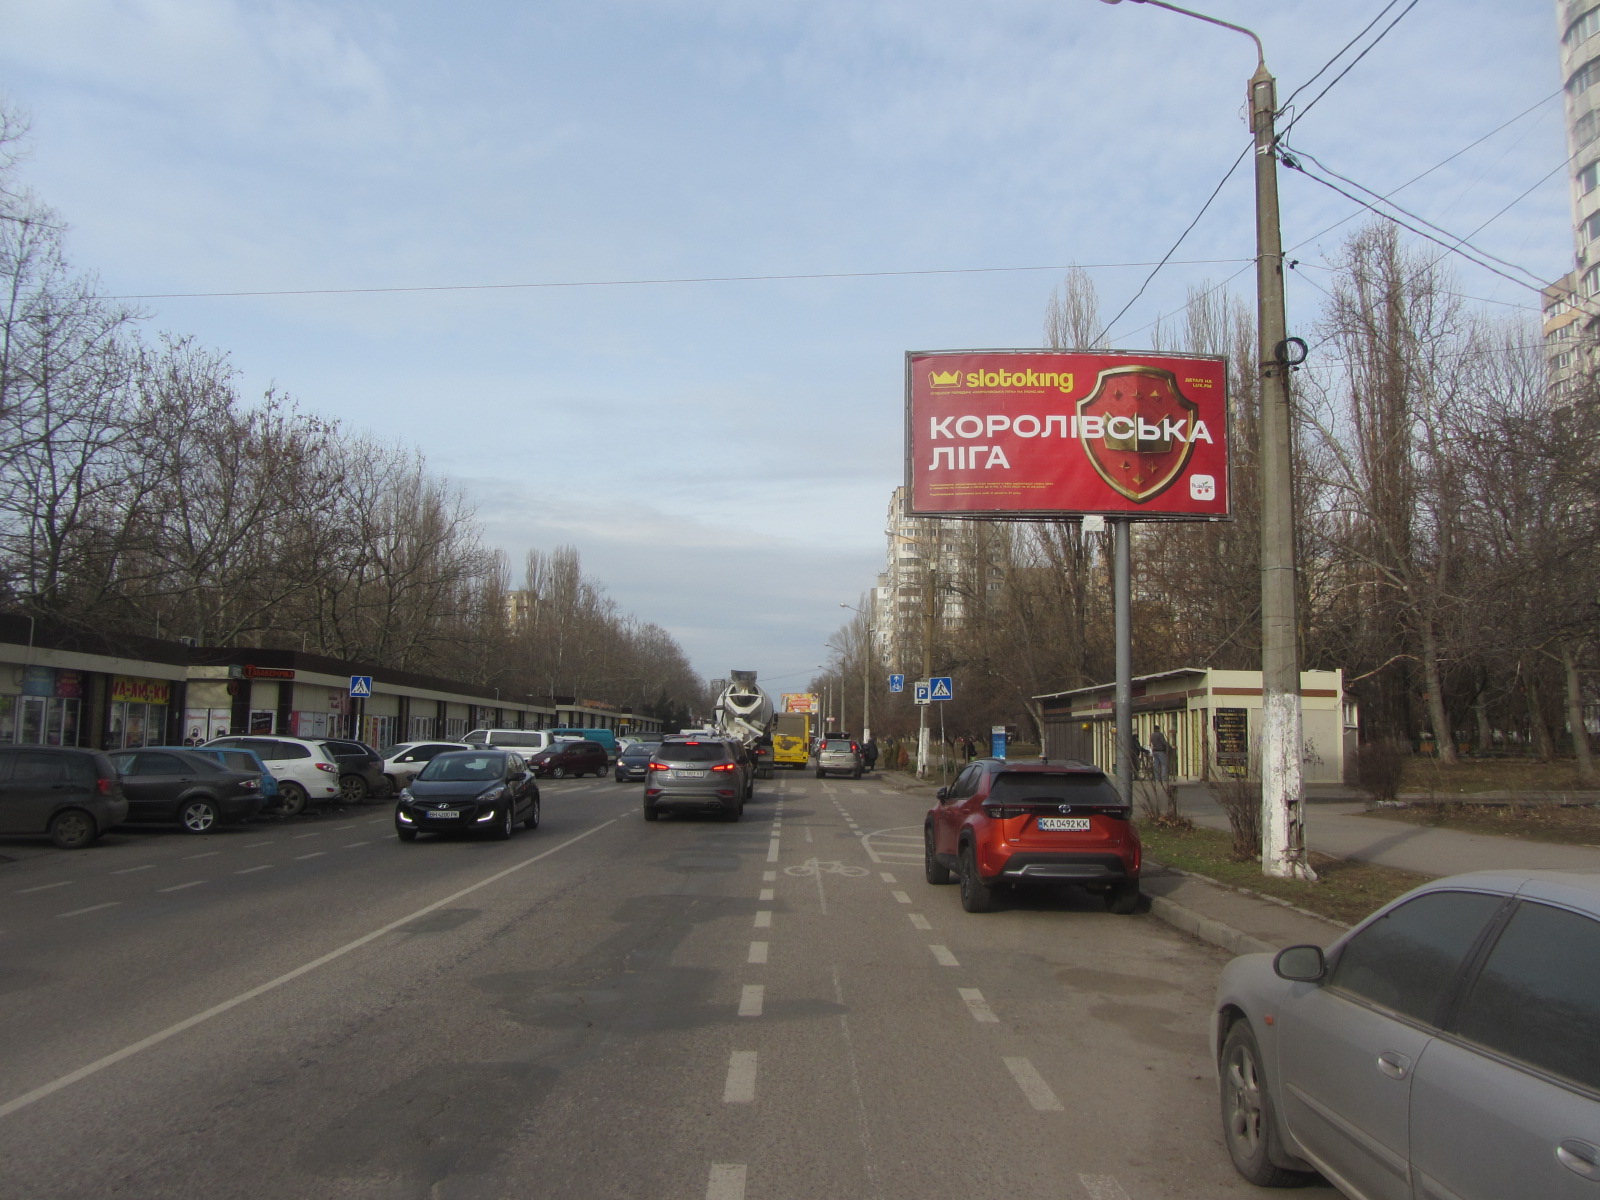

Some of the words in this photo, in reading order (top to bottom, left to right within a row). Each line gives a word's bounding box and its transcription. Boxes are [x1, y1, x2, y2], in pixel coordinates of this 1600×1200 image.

[930, 415, 1213, 444] КОРОЛІВСЬКА
[928, 446, 1011, 470] ЛІГА
[1043, 820, 1054, 828] KA
[1056, 820, 1076, 828] 0492
[1077, 820, 1088, 828] KK
